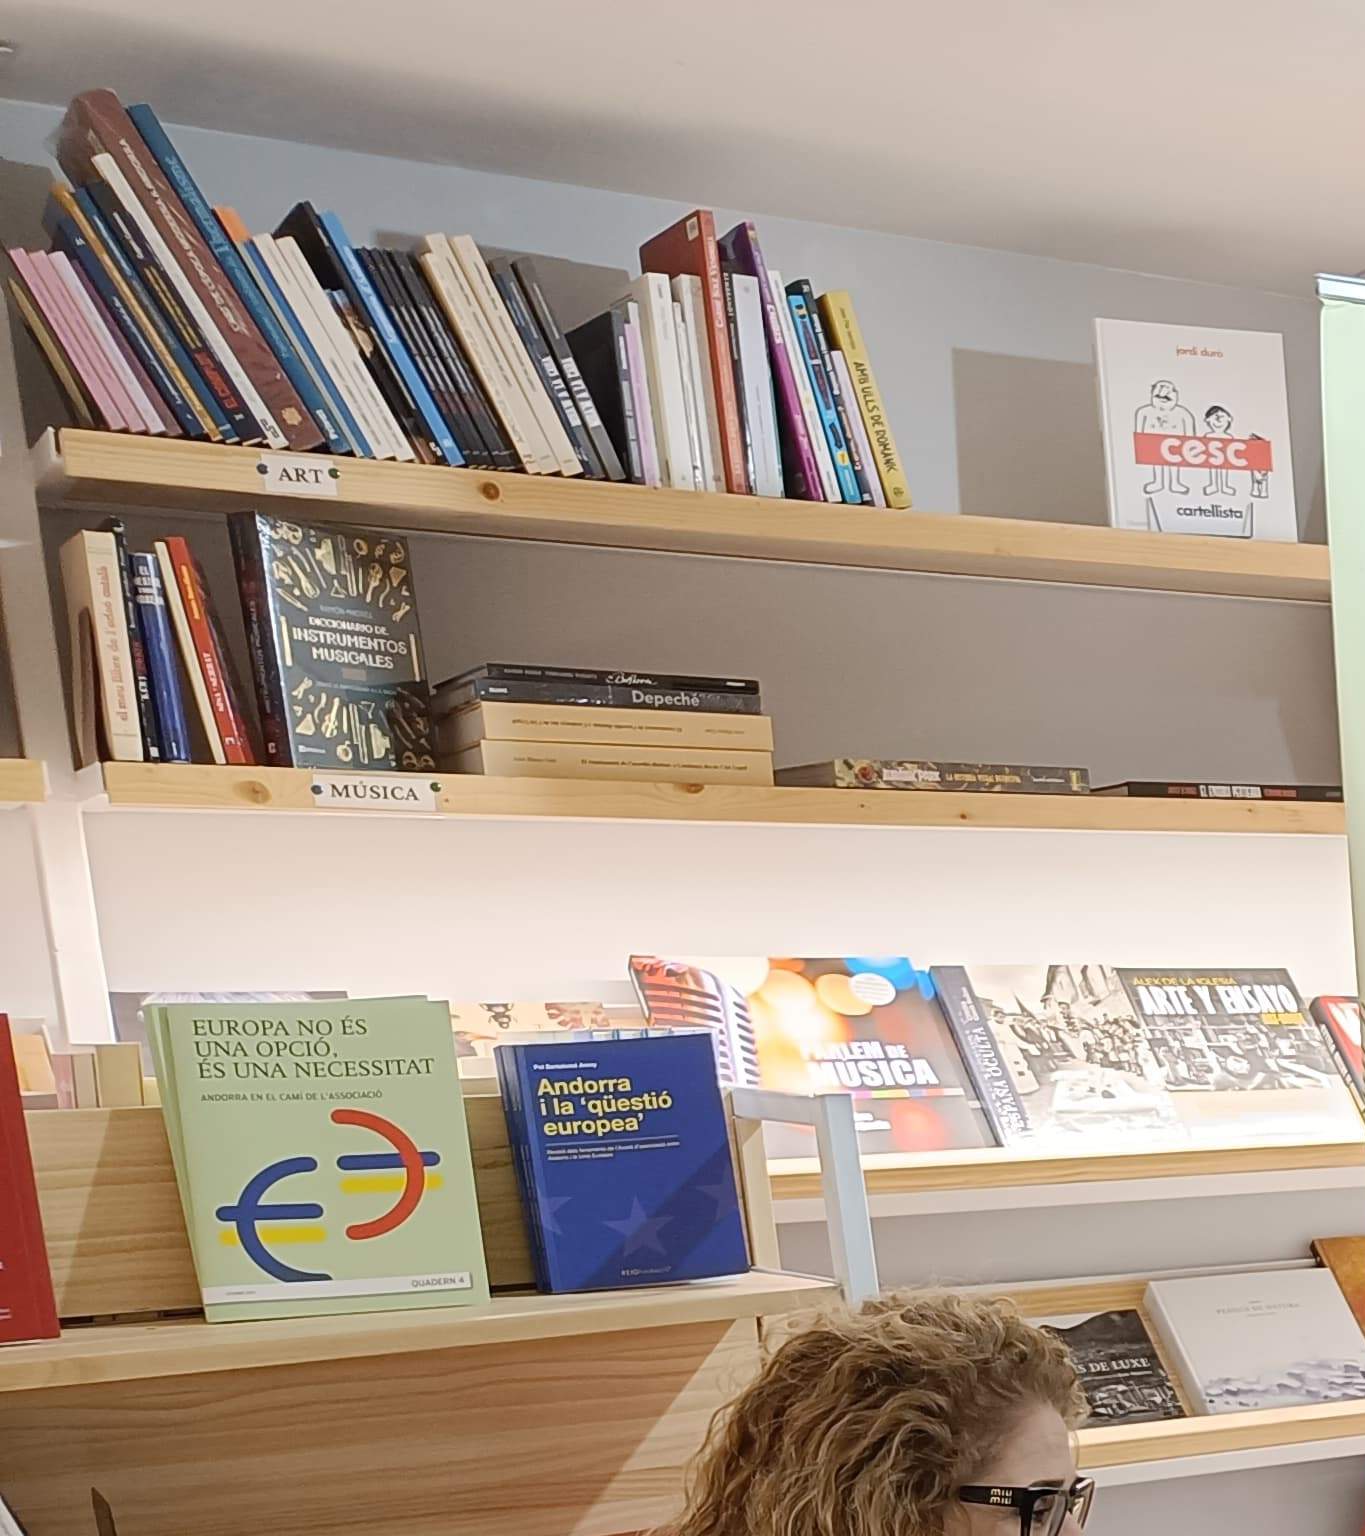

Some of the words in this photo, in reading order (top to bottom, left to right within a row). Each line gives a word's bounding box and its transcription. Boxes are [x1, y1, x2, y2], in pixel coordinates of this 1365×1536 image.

[1160, 438, 1248, 467] cesc
[279, 467, 324, 485] ART
[1176, 504, 1244, 520] cartellista
[309, 616, 370, 633] DICCIONARIO
[292, 628, 408, 656] INSTRUMENTOS
[311, 646, 394, 669] MUSICALES
[330, 781, 419, 801] MÚSICA
[1136, 985, 1198, 1015] ARTE
[1195, 986, 1216, 1015] Y
[1216, 984, 1302, 1015] ENSAYO
[192, 1019, 290, 1037] EUROPA
[297, 1019, 333, 1036] NO
[341, 1015, 368, 1036] ÉS
[195, 1040, 248, 1058] UNA
[256, 1037, 338, 1059] OPCIÓ,
[884, 1044, 909, 1059] DE
[199, 1058, 226, 1079] ÉS
[233, 1061, 287, 1079] UNA
[294, 1058, 434, 1079] NECESSITAT
[537, 1077, 631, 1096] Andorra
[200, 1093, 248, 1102] ANDORRA
[250, 1093, 264, 1101] EN
[265, 1093, 277, 1101] EL
[278, 1092, 303, 1101] CAMÍ
[306, 1092, 318, 1100] DE
[540, 1099, 547, 1116] i
[553, 1098, 575, 1116] la
[411, 1277, 453, 1288] QUADERN
[457, 1276, 465, 1284] 4
[1090, 1360, 1108, 1372] DE
[1111, 1356, 1150, 1371] LUXE
